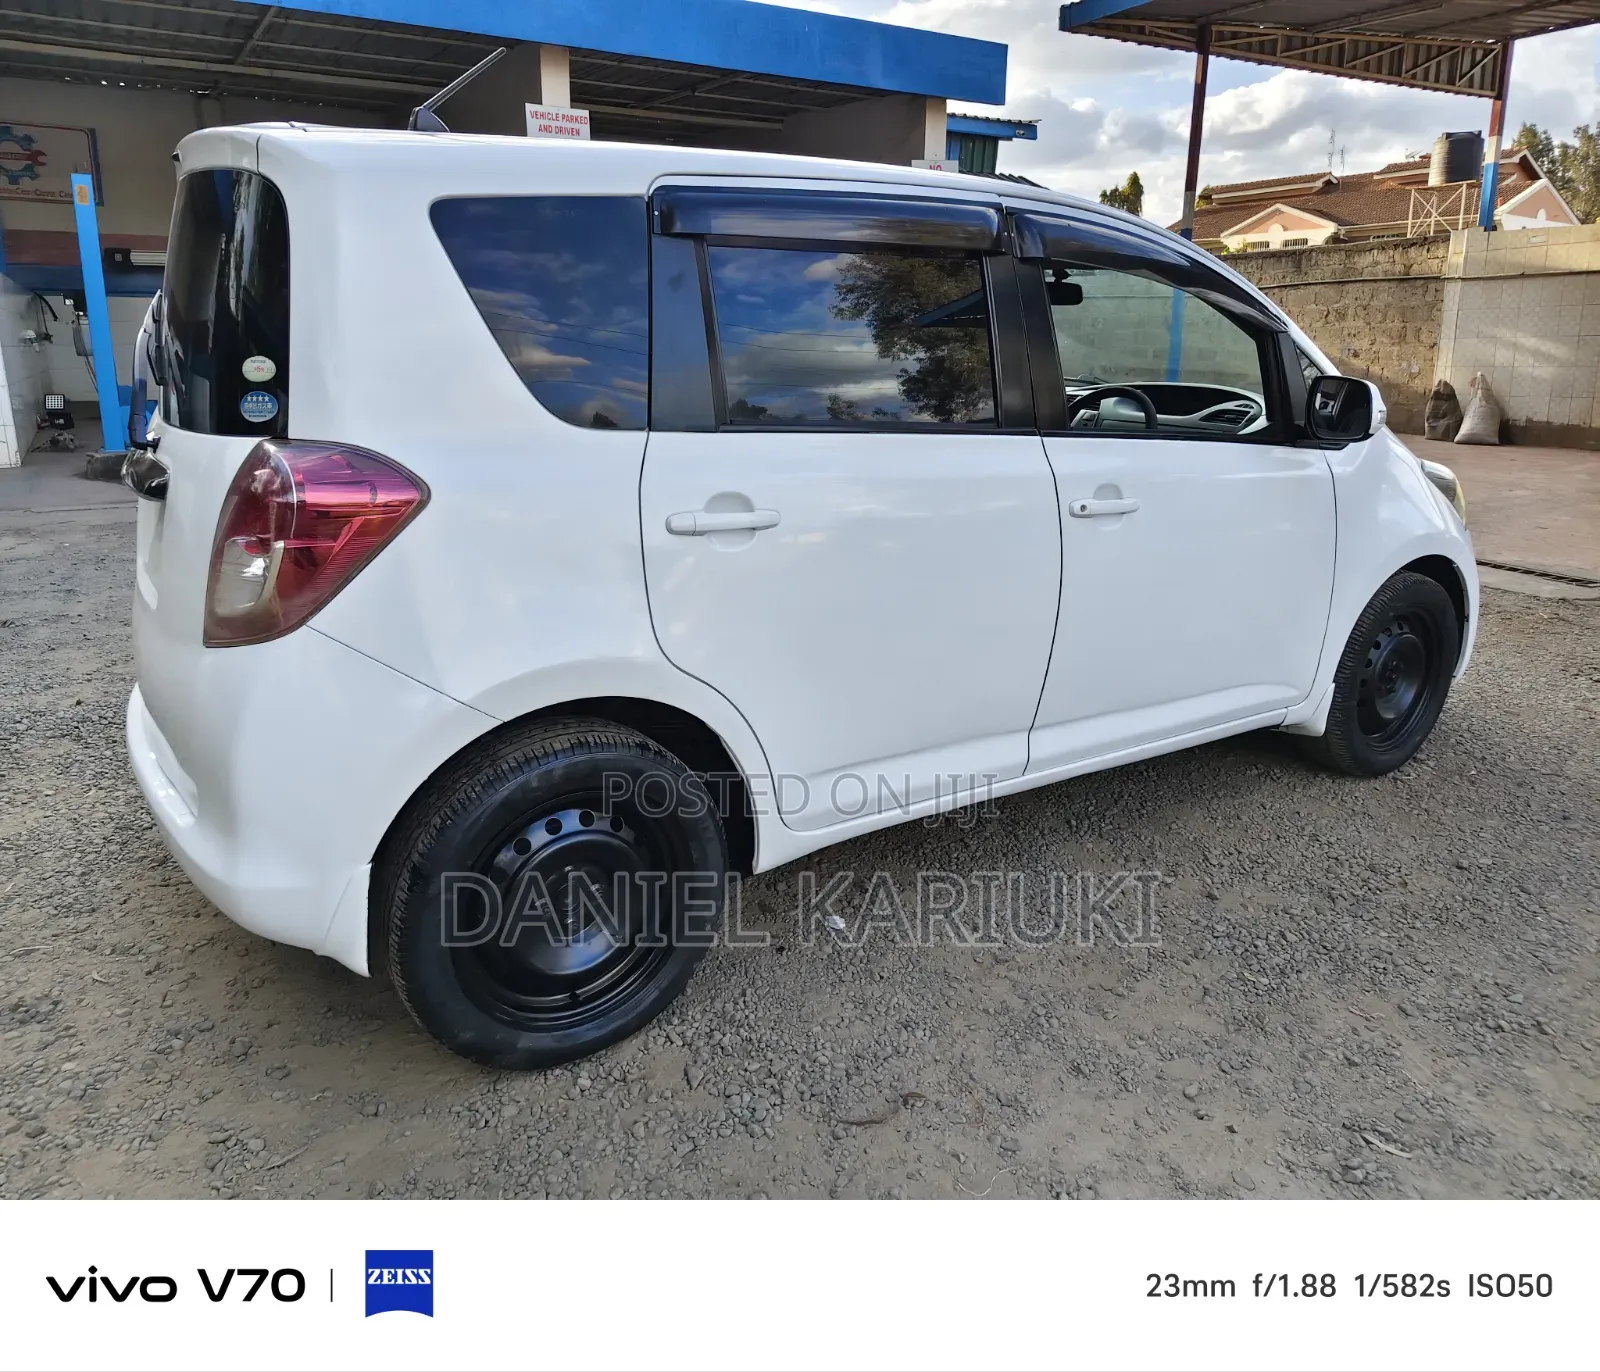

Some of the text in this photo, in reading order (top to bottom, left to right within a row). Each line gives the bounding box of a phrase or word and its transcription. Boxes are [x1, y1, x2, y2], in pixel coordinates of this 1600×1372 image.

[529, 110, 588, 125] VEHICLE PARKED
[538, 124, 580, 136] AND DRIVEN
